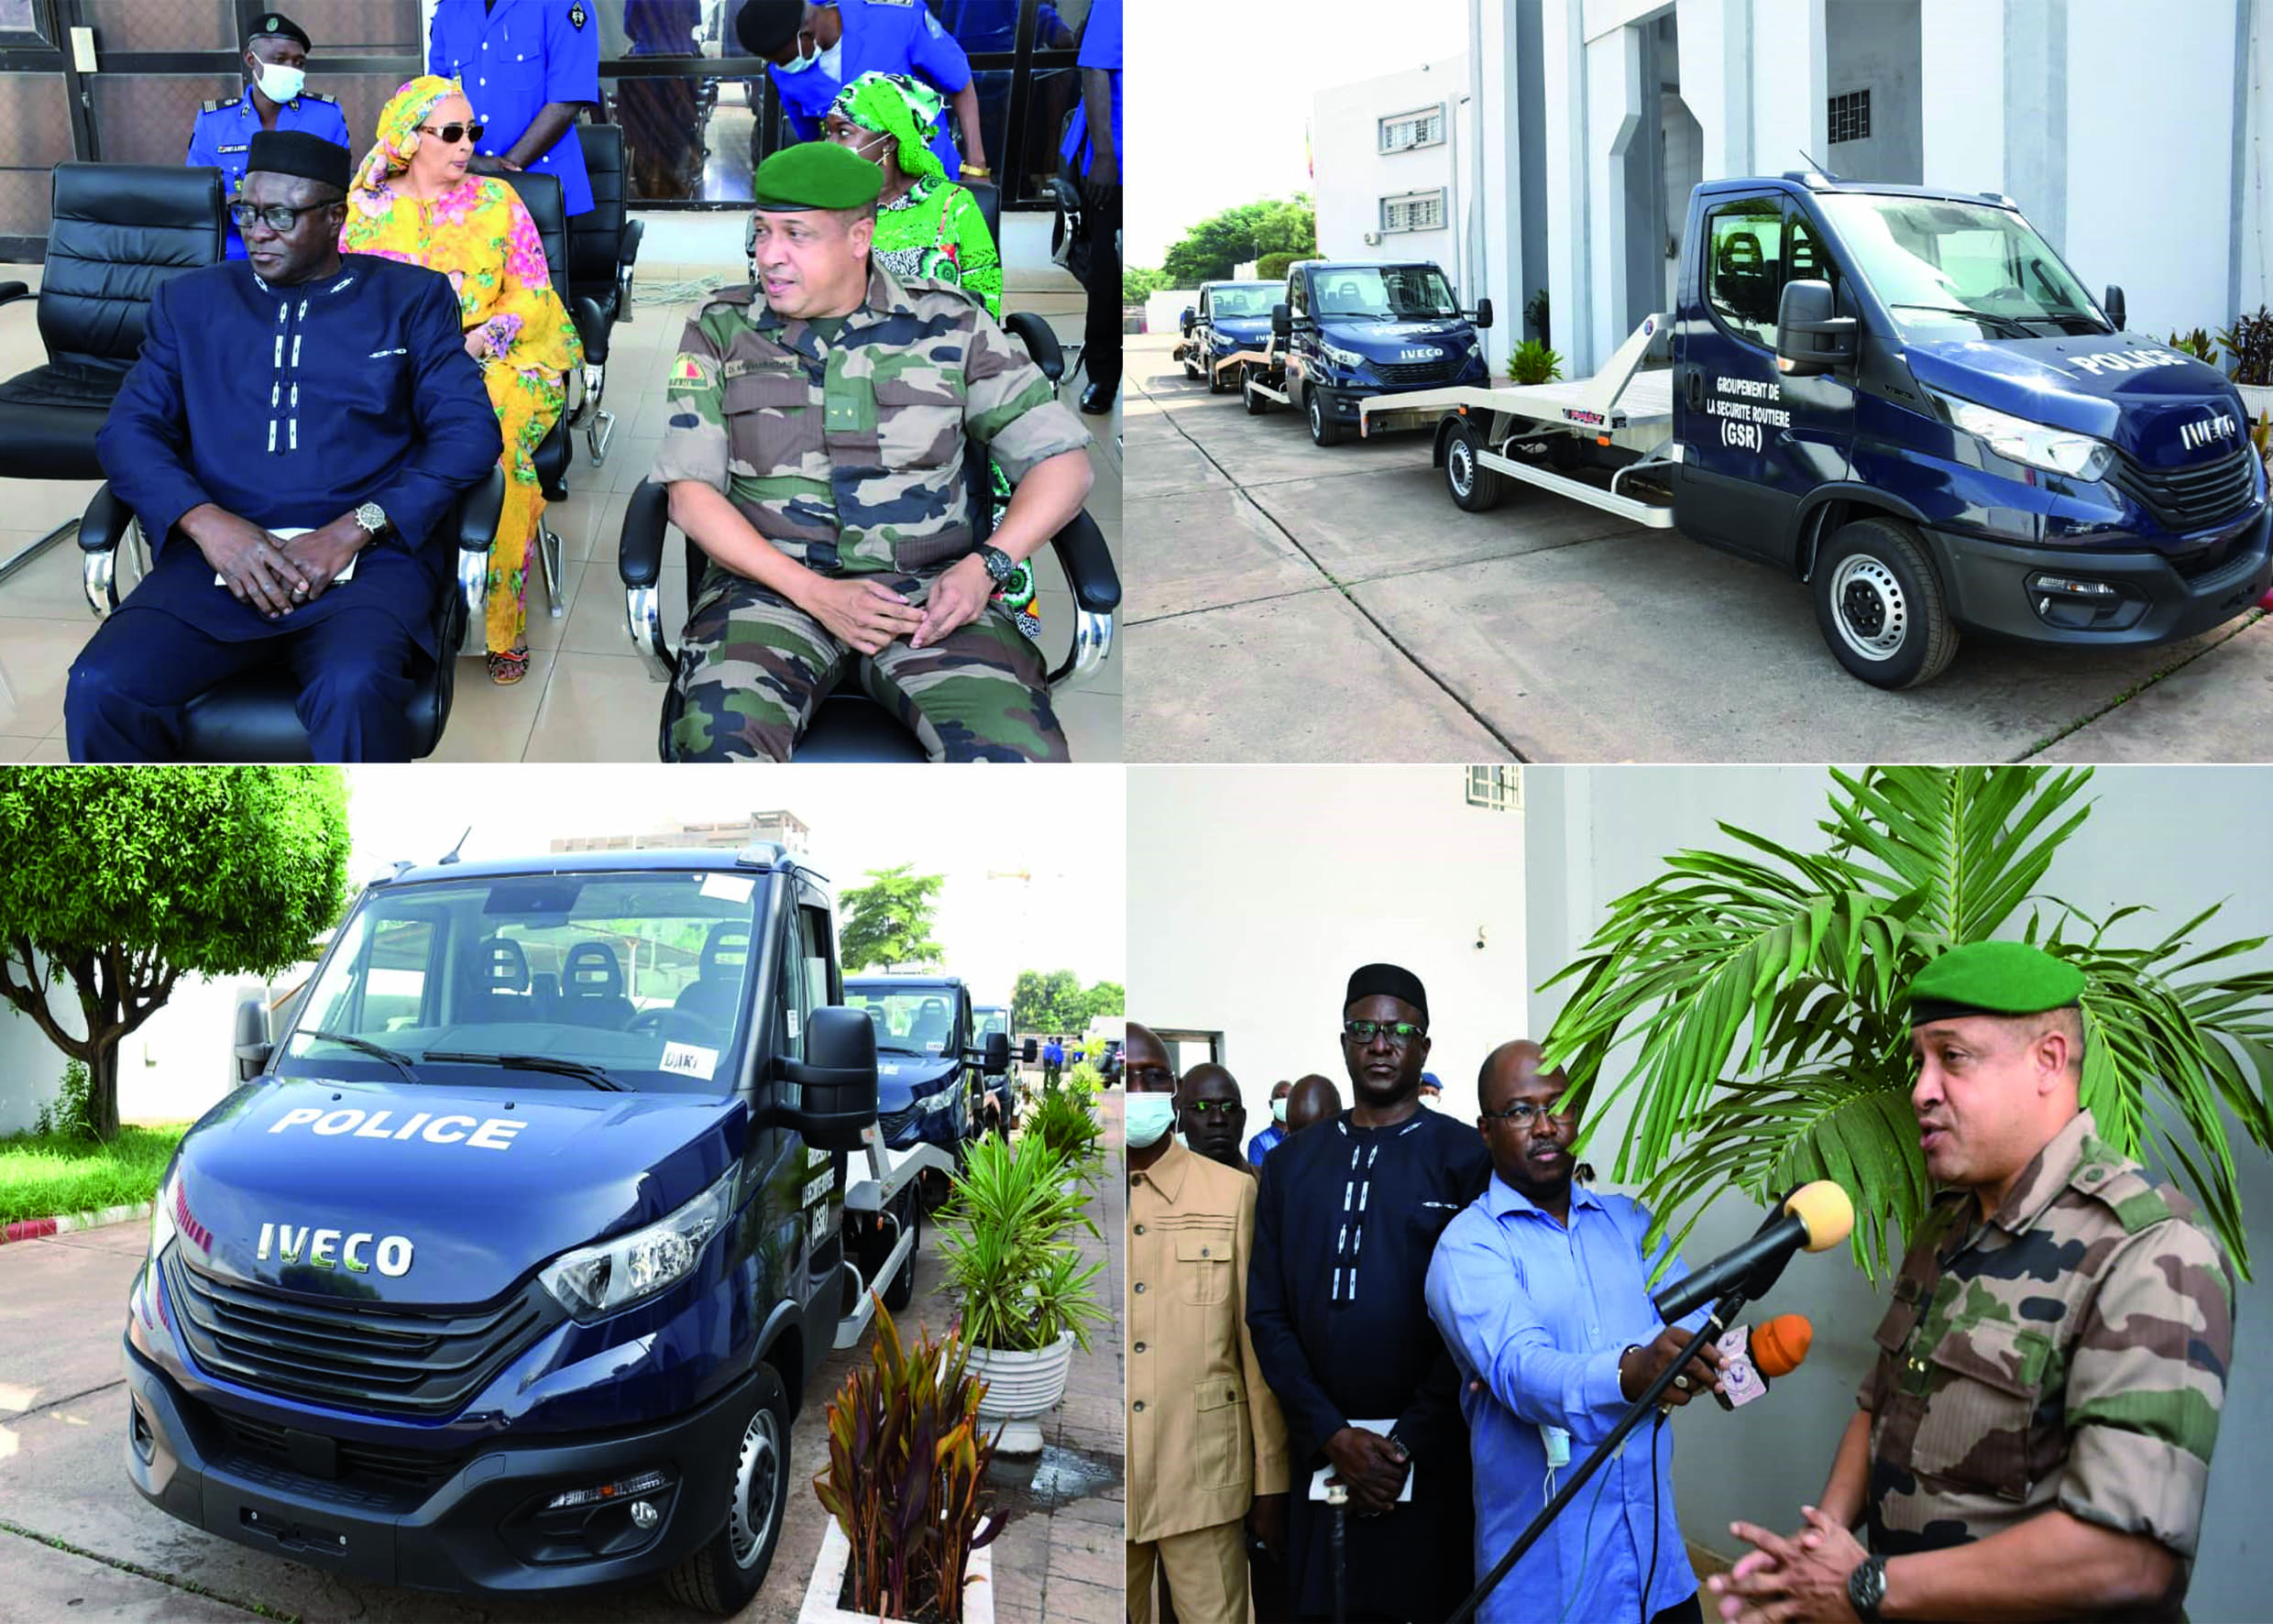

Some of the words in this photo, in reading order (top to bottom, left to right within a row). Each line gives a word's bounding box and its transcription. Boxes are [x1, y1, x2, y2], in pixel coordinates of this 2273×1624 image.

[1400, 347, 1444, 359] IVECO
[2067, 349, 2189, 376] POLICE
[1717, 376, 1767, 400] GROUPEMENT
[1768, 383, 1780, 401] DE
[1707, 398, 1716, 415] LA
[1717, 400, 1751, 421] SECURITE
[1751, 405, 1790, 428] ROUTIERE
[1720, 418, 1762, 453] (GSR)
[2180, 414, 2235, 451] IVECO
[268, 1108, 529, 1150] POLICE
[257, 1223, 414, 1277] IVECO
